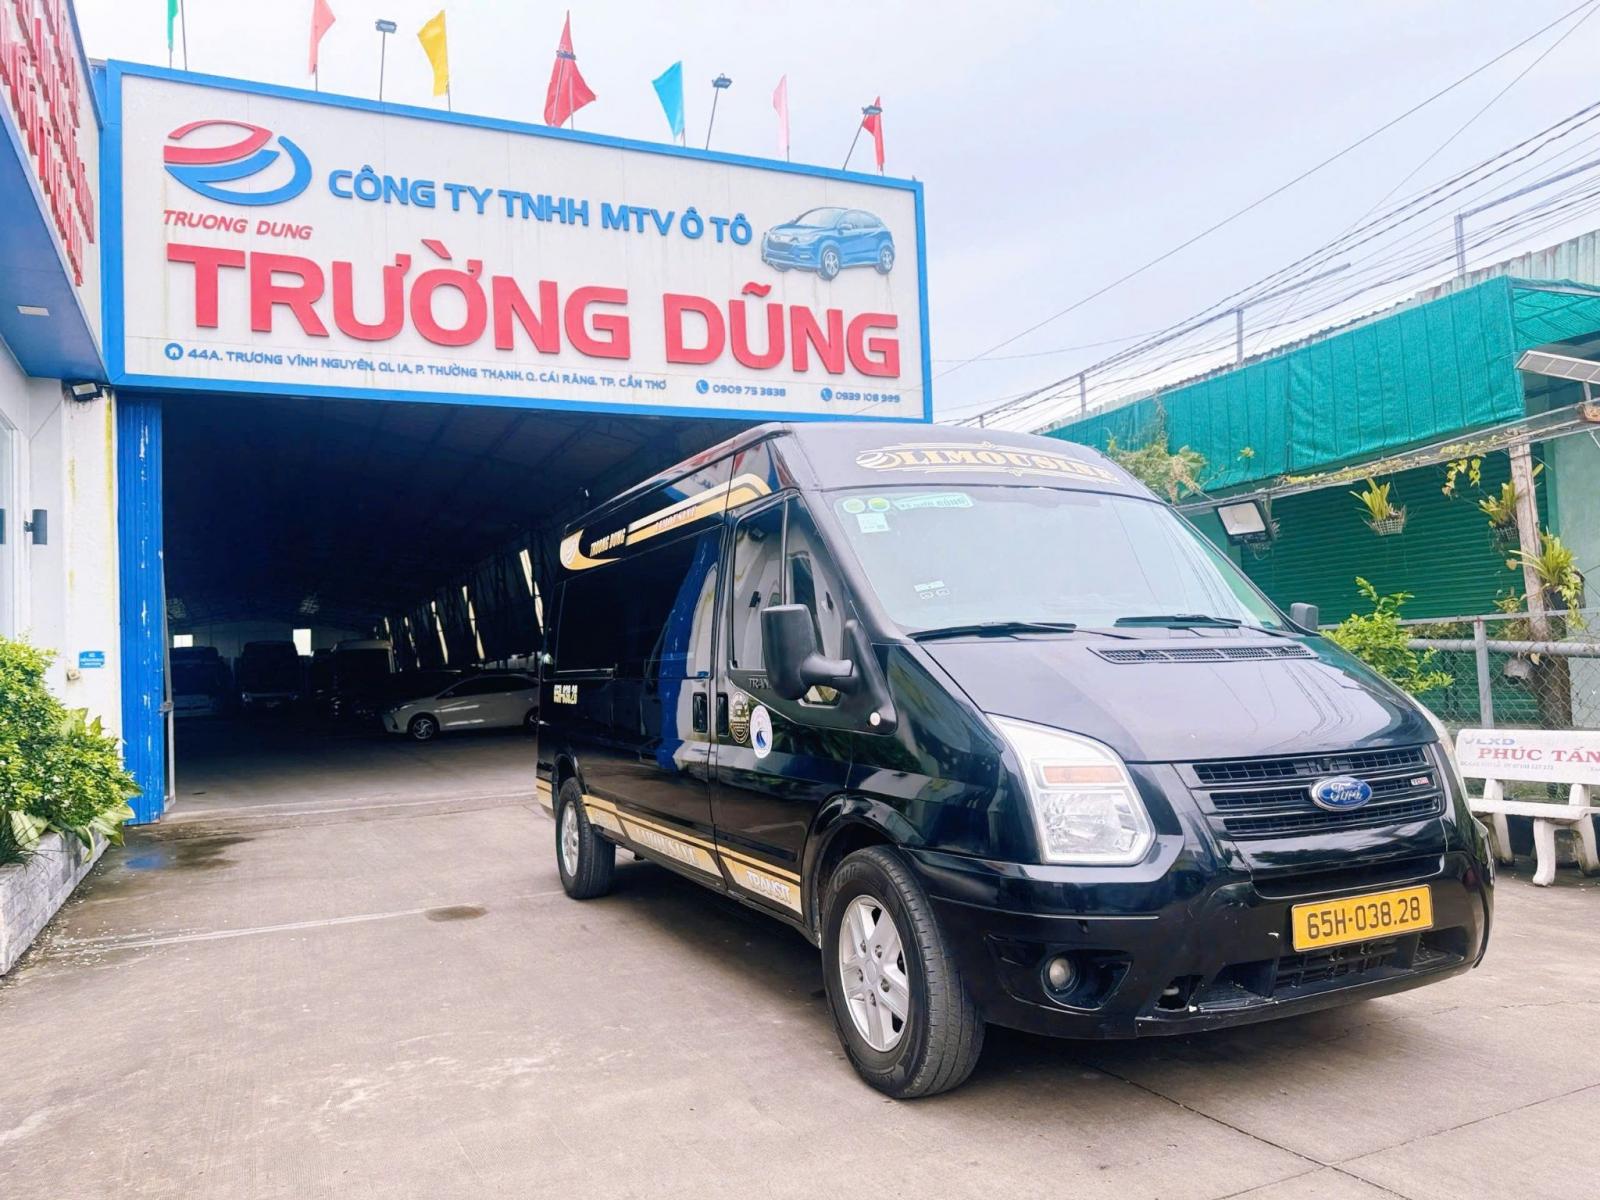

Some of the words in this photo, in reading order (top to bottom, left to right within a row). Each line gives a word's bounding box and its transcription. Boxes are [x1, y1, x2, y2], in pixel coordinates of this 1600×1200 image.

[328, 164, 436, 209] CÔNG
[444, 182, 493, 215] TY
[498, 188, 589, 227] TNHH
[601, 202, 675, 236] MTV
[680, 206, 704, 240] Ô
[709, 212, 753, 246] TÔ
[163, 209, 249, 234] TRUONG
[255, 220, 314, 241] DUNG
[166, 238, 632, 361] TRƯỜNG
[662, 280, 901, 379] DŨNG
[226, 350, 283, 365] TRƯƠNG
[712, 384, 742, 395] 0909
[1477, 745, 1543, 761] PHÚC
[1330, 782, 1364, 803] Ford
[1306, 896, 1421, 940] 65H-038.28
